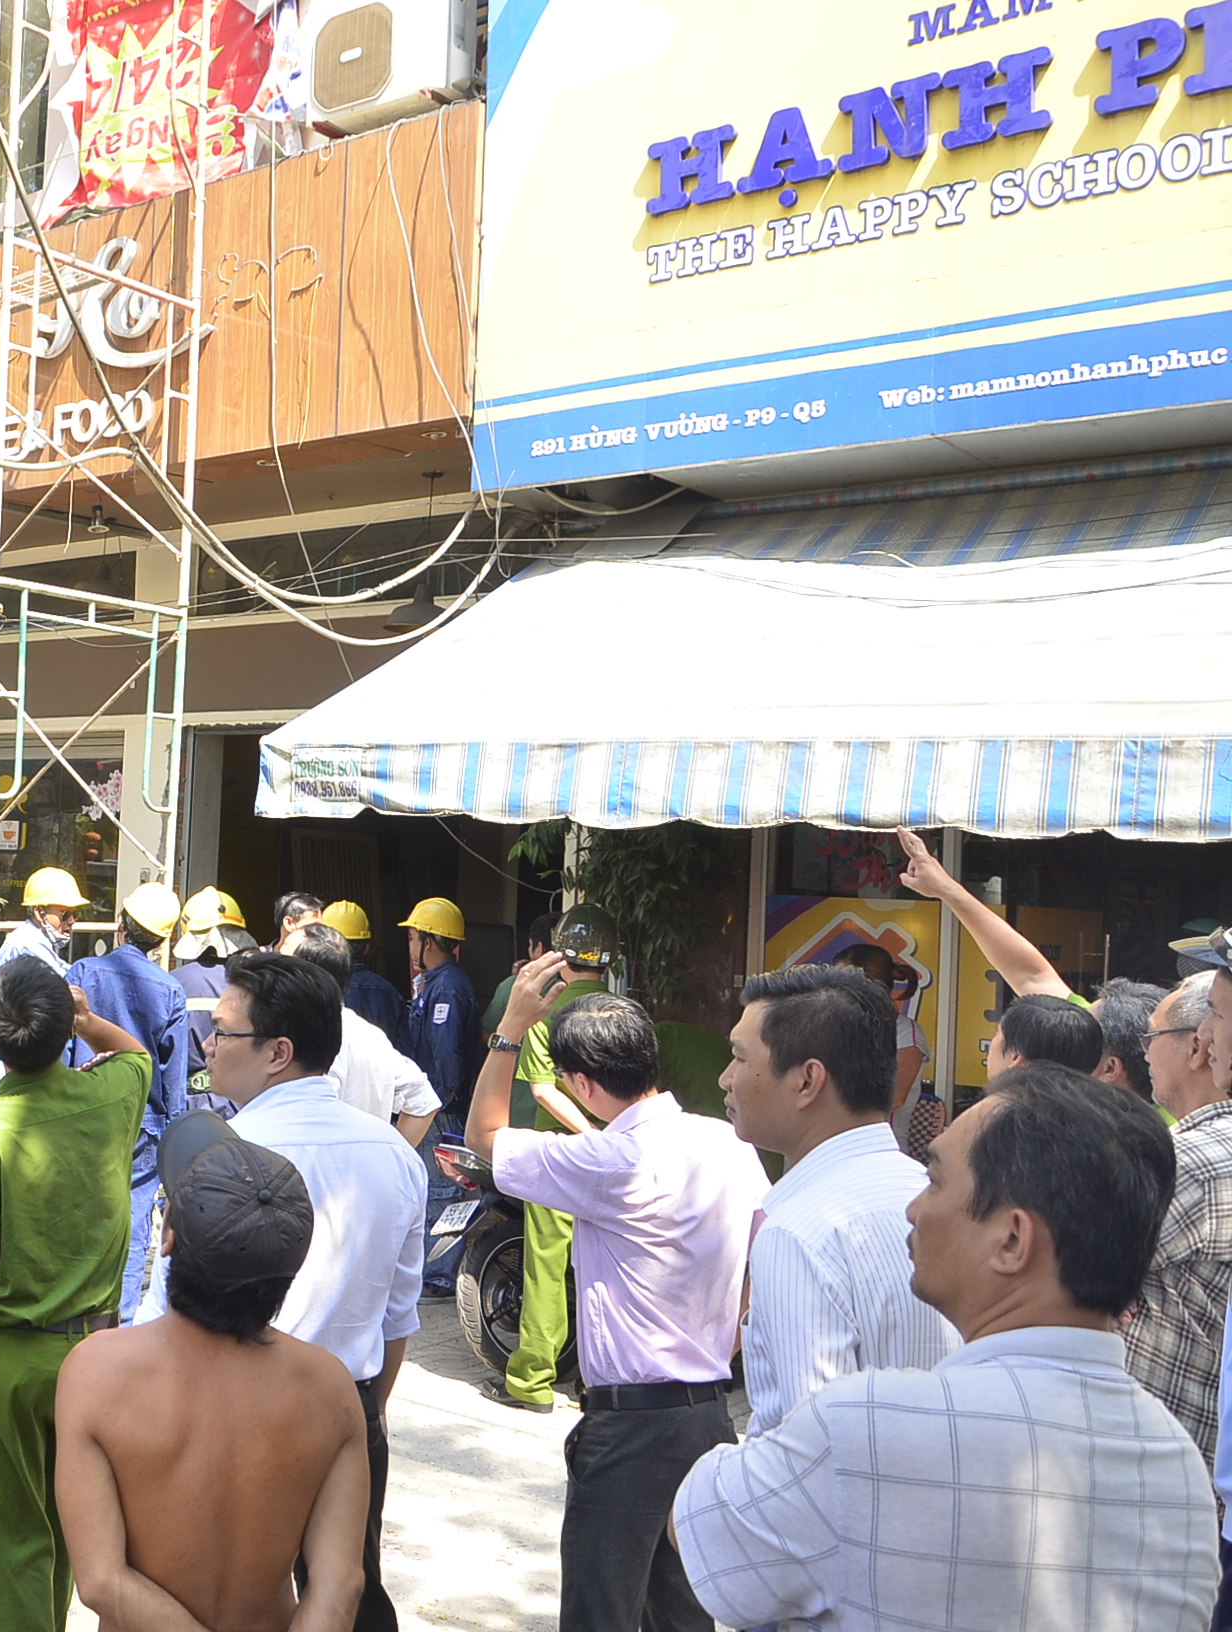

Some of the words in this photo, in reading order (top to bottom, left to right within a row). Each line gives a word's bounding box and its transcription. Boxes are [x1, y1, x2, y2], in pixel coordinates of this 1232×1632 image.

[646, 46, 1056, 208] HẠNH
[646, 225, 755, 284] THE
[765, 179, 977, 260] HAPPY
[54, 389, 155, 447] FOOD
[878, 384, 946, 409] Web:
[530, 437, 566, 458] 291
[568, 425, 639, 453] HÙNG
